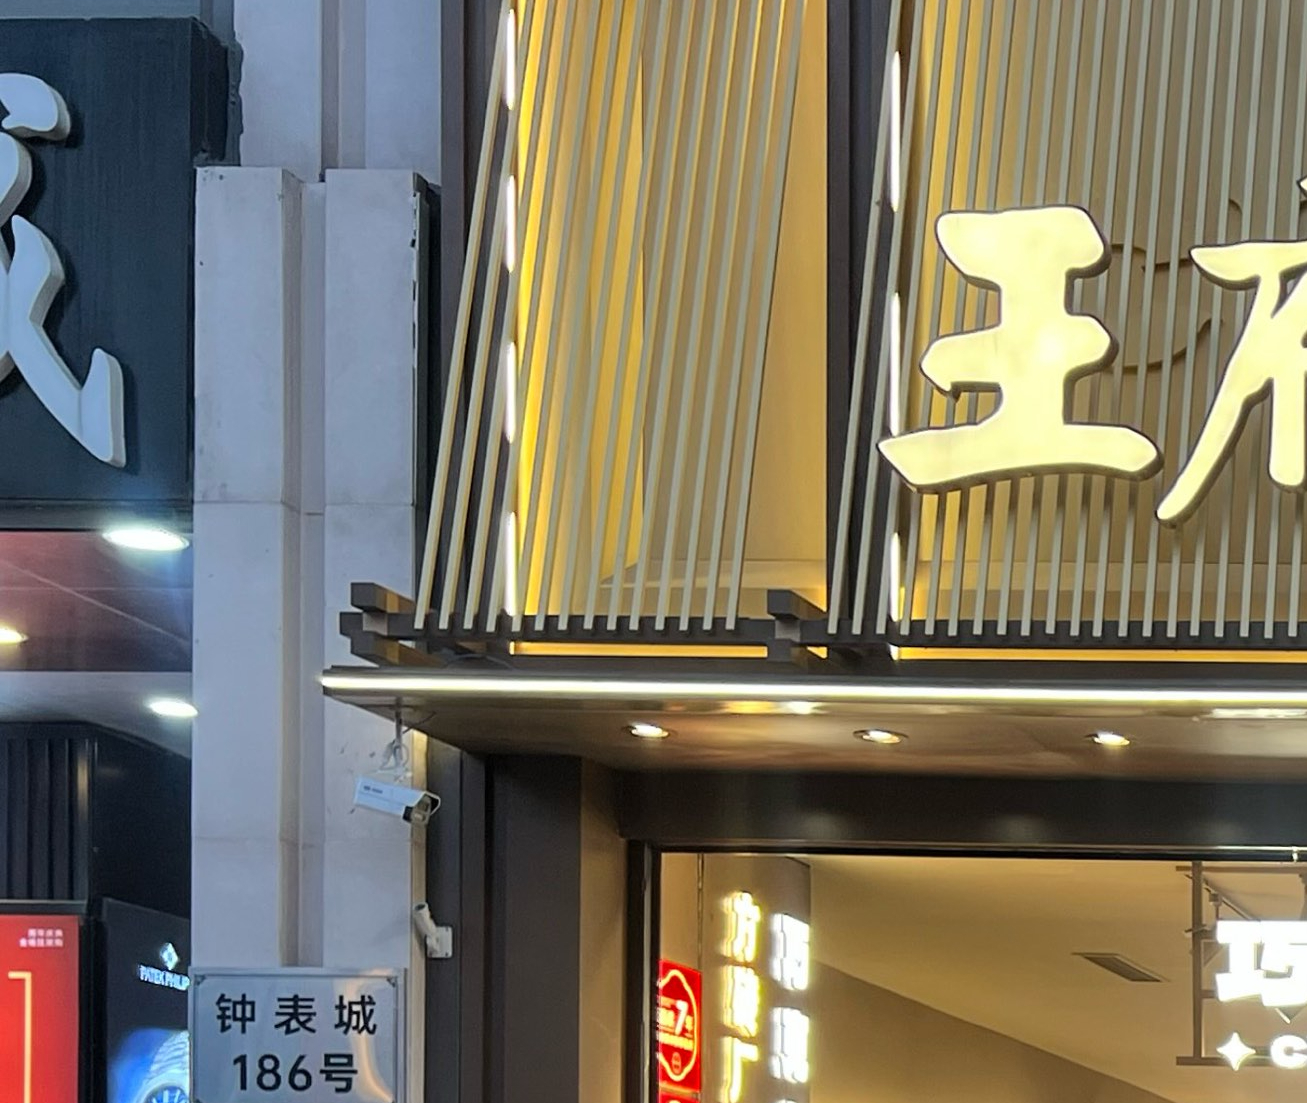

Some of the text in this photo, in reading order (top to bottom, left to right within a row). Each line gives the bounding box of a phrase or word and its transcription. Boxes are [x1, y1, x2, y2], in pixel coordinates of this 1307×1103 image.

[215, 993, 378, 1035] 钟表城
[231, 1053, 359, 1094] 186号
